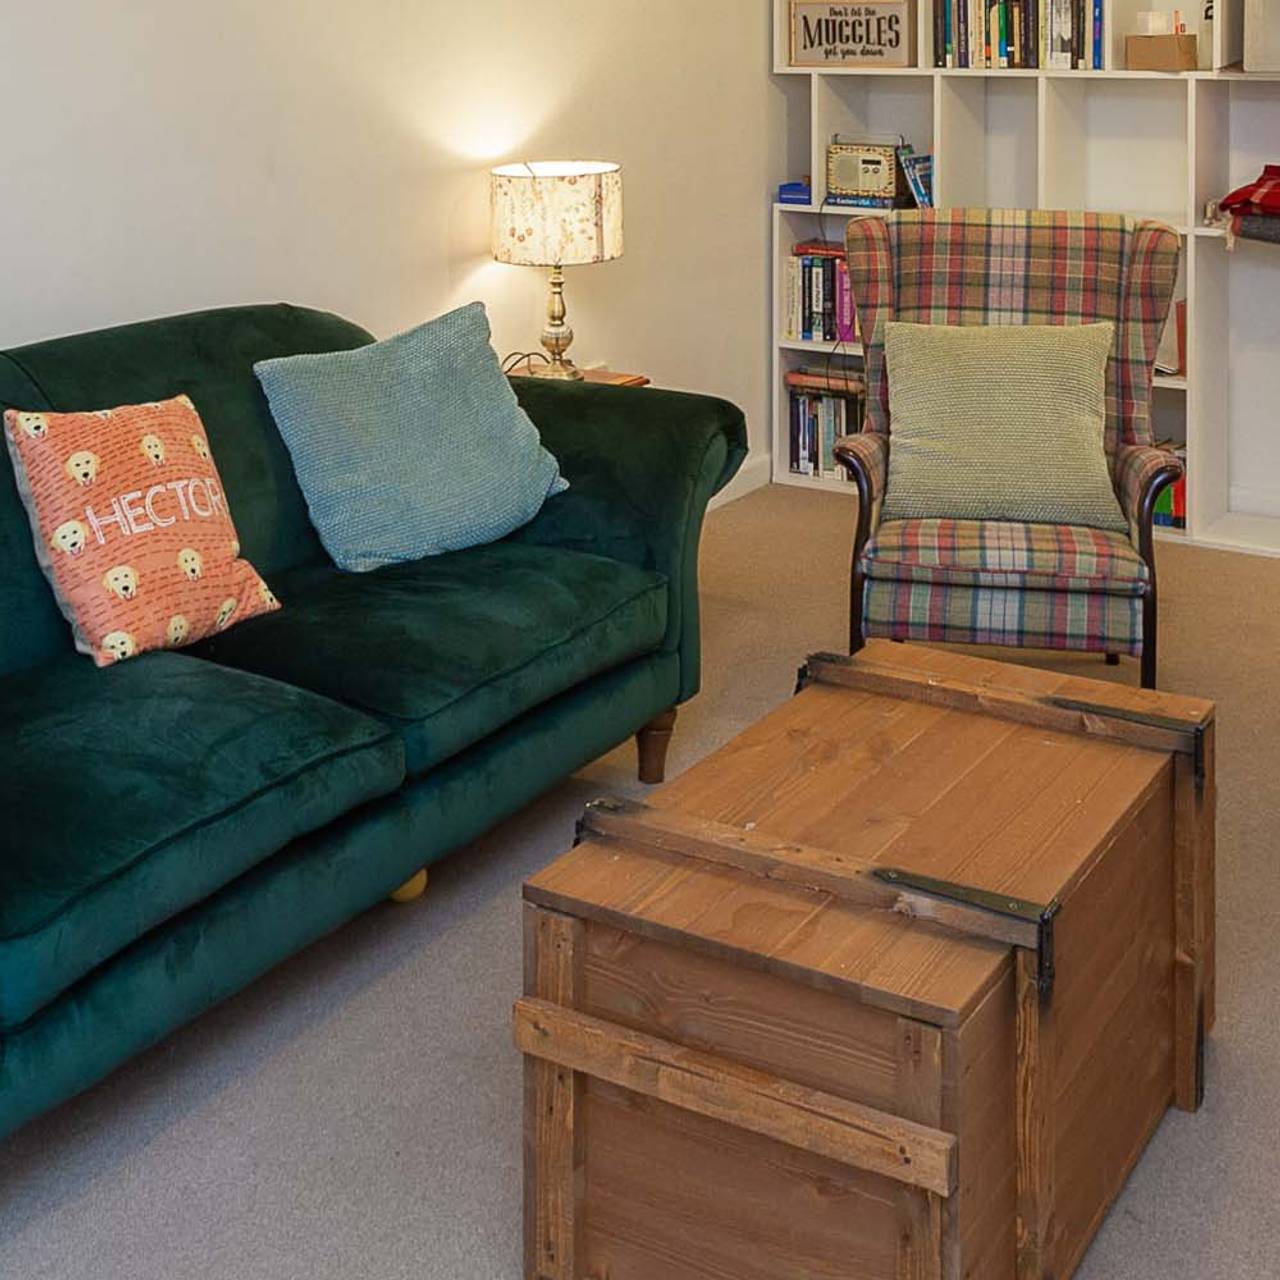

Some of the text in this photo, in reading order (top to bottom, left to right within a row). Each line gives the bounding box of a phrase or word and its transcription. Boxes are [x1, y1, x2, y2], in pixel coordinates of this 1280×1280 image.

[802, 14, 900, 50] MUGGLES
[824, 45, 885, 60] get you down
[84, 477, 224, 545] HECTOR
